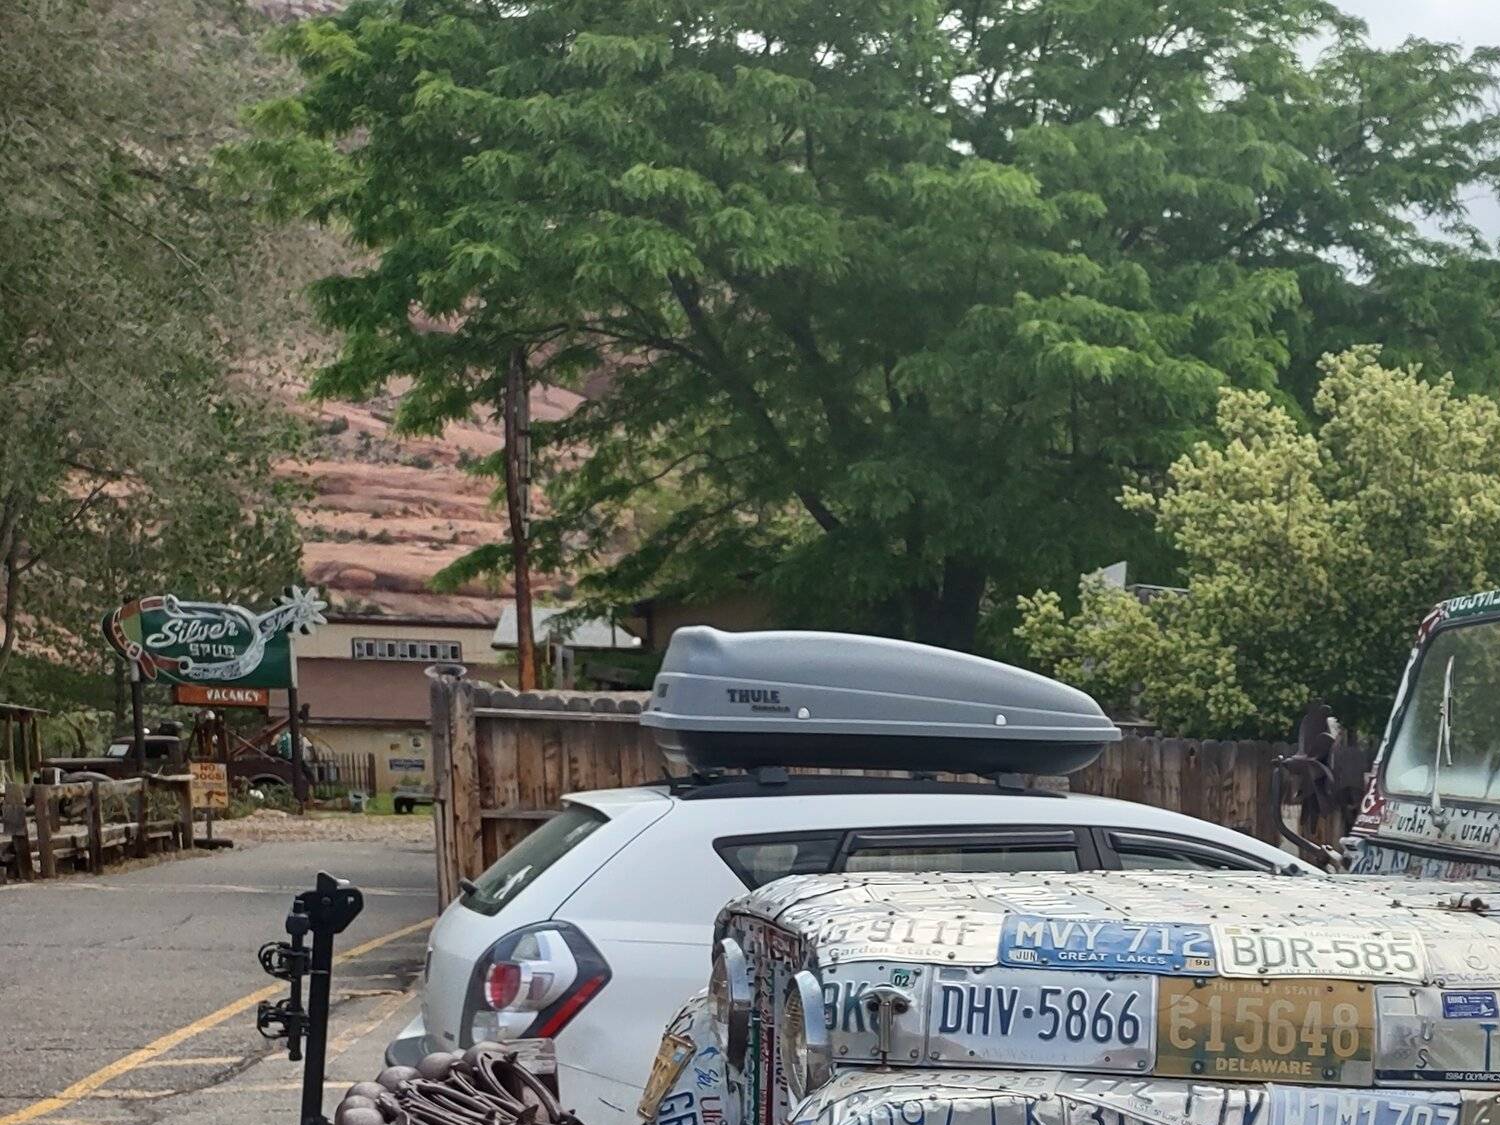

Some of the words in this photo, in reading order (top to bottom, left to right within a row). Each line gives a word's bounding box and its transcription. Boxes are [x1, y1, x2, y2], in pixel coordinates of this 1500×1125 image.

[146, 617, 239, 648] Silver
[189, 643, 236, 659] SPUR
[206, 688, 262, 702] VACANCY
[726, 688, 781, 703] THULE
[1397, 815, 1426, 834] UTAH
[1461, 823, 1492, 843] UTAH
[1014, 920, 1105, 951] MVY
[1123, 925, 1212, 958] 712
[1016, 950, 1039, 962] JUN
[1058, 951, 1109, 964] GREAT
[1116, 953, 1167, 966] LAKES
[1231, 935, 1417, 973] BDR-585
[1195, 959, 1211, 968] 98
[1215, 1056, 1313, 1076] DELAWARE
